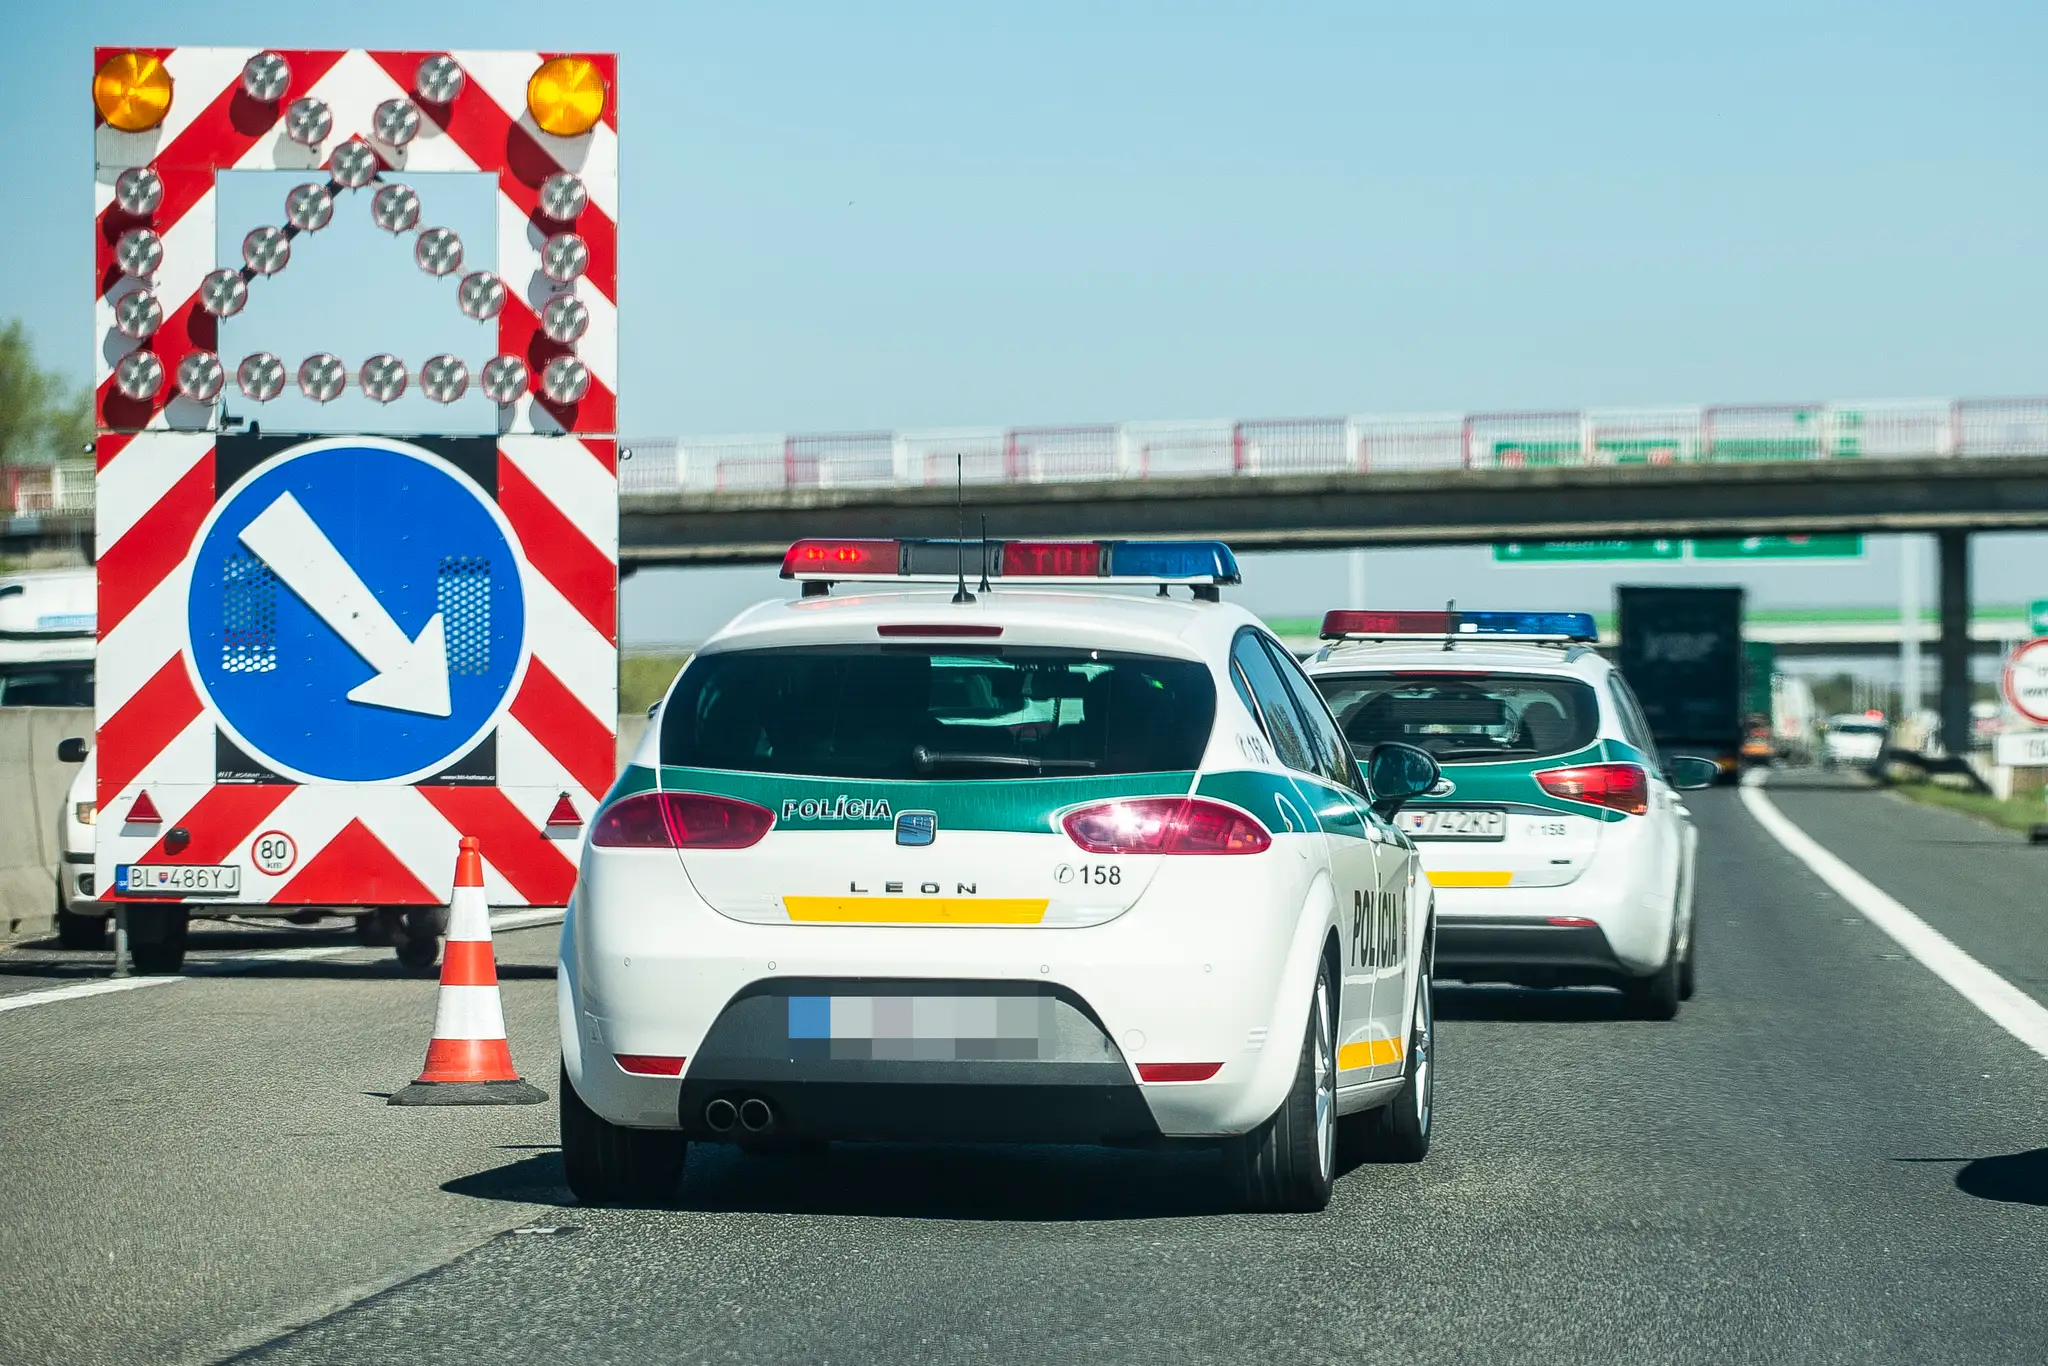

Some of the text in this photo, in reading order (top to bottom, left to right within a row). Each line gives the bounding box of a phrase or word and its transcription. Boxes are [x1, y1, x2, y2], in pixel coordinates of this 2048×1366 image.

[782, 795, 892, 821] POLÍCIA
[261, 840, 286, 859] 80
[266, 861, 282, 869] km
[1079, 865, 1122, 885] 158
[131, 868, 236, 889] BL 486YJ
[850, 881, 977, 895] LEON
[1350, 872, 1398, 968] POLÍCIA
